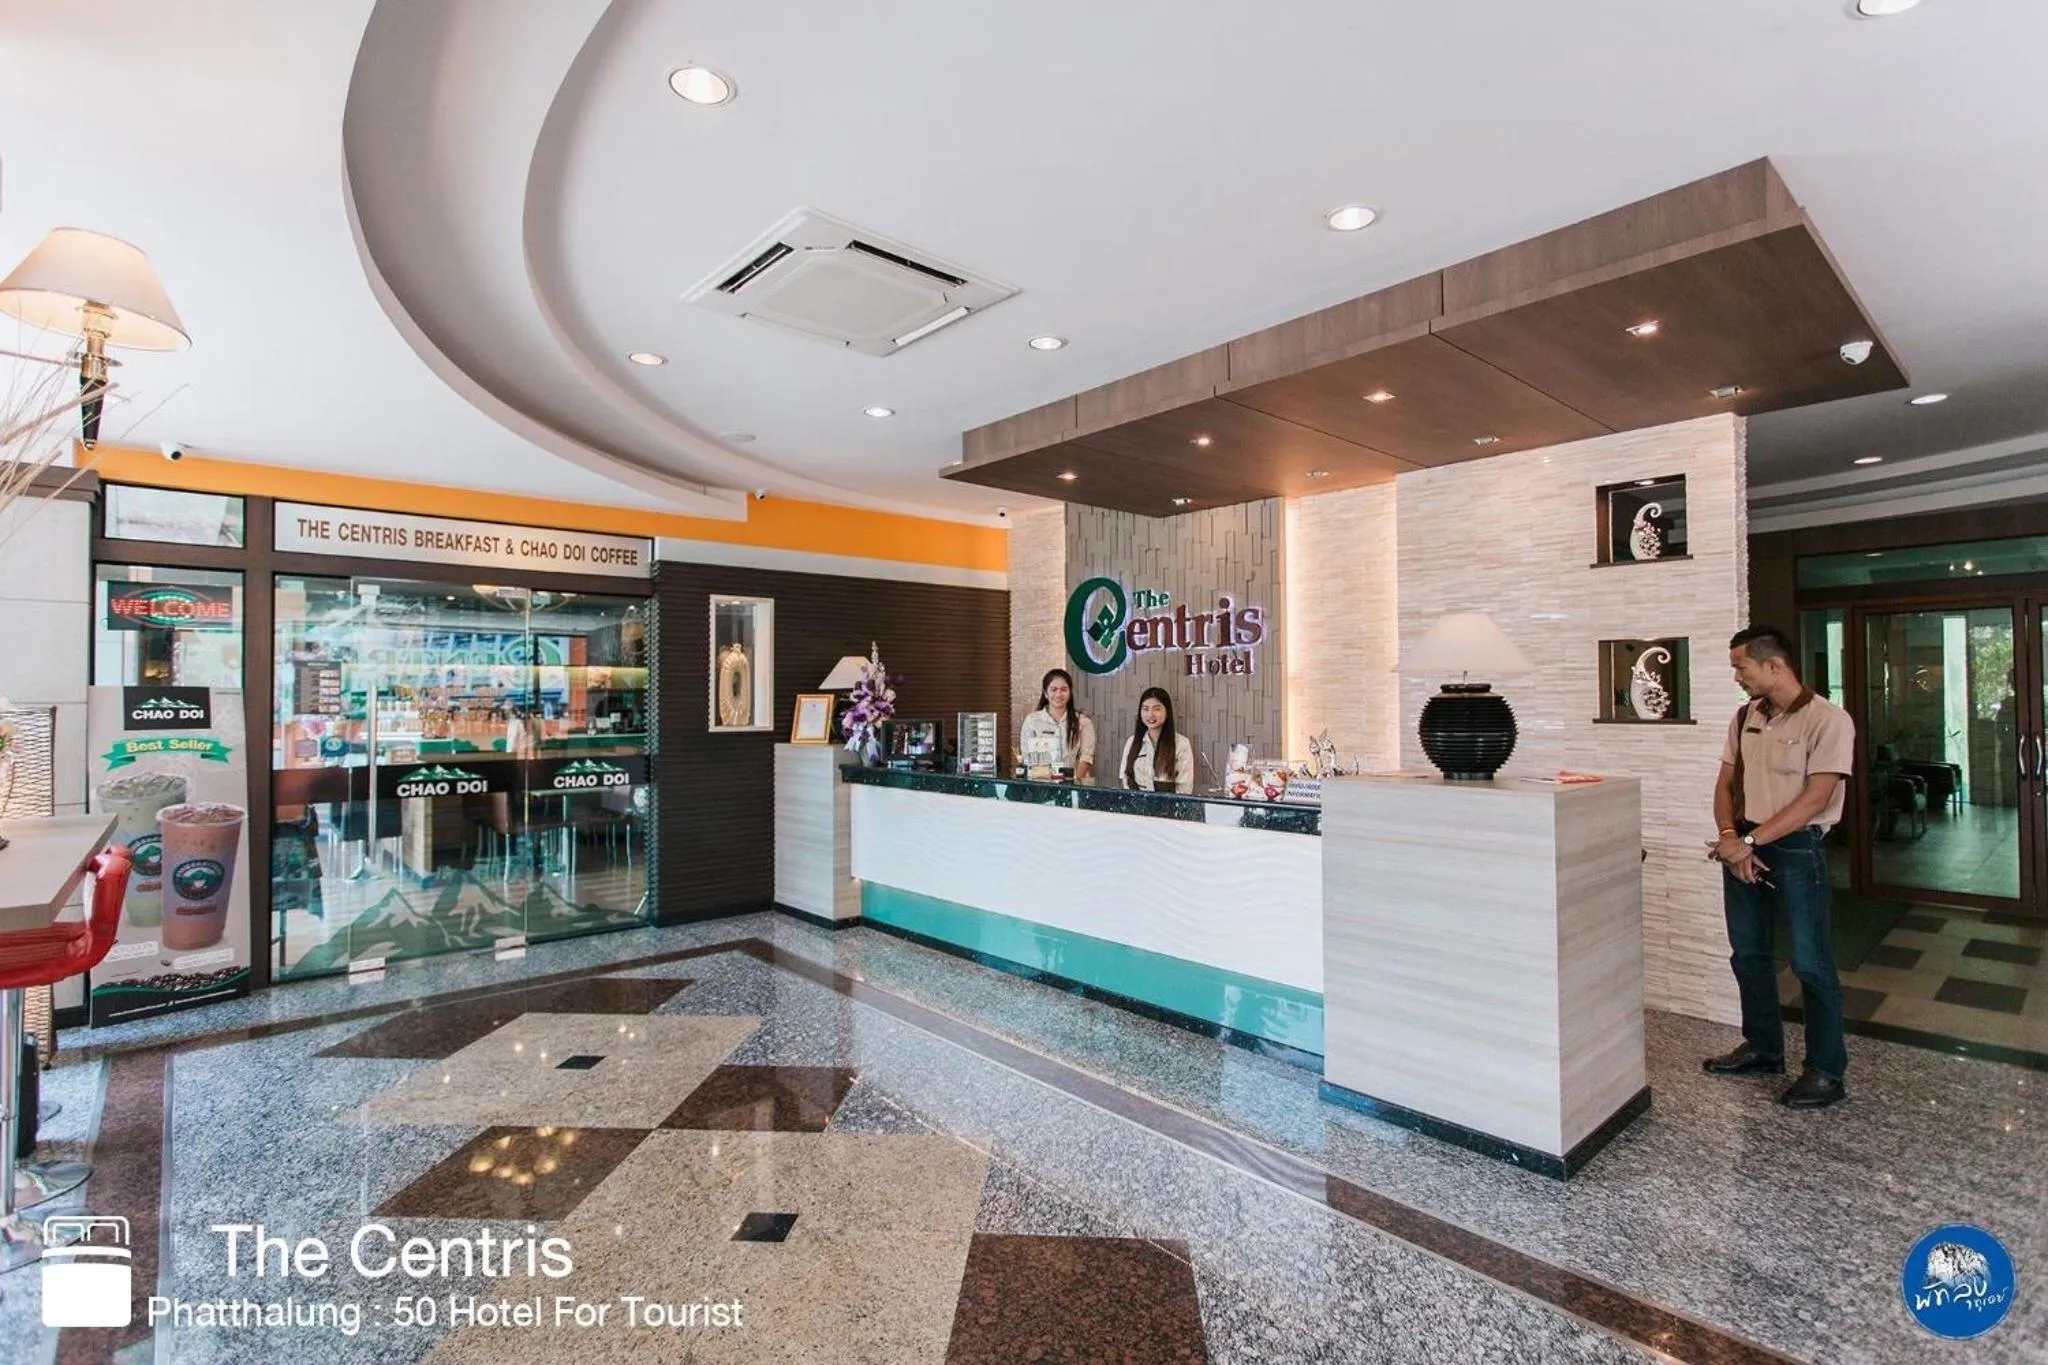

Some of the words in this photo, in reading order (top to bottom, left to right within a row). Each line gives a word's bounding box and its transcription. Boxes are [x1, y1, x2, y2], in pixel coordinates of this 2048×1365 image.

[297, 518, 330, 540] THE
[338, 523, 407, 546] CENTRIS
[414, 529, 500, 555] BREAKFAST
[506, 540, 515, 556] &
[520, 540, 558, 559] CHAO
[563, 544, 586, 562] DOI
[591, 546, 639, 566] COFFEE
[111, 597, 232, 618] WELCOME
[1132, 589, 1170, 608] The
[1063, 576, 1265, 675] Centris
[1186, 651, 1254, 676] Hotel
[132, 709, 175, 720] CHAO
[179, 709, 204, 719] DOI
[125, 740, 164, 753] Best
[170, 739, 214, 751] Seller
[397, 782, 450, 798] CHAO
[456, 780, 489, 794] DOI
[553, 775, 598, 789] CHAO
[603, 773, 630, 786] DOI
